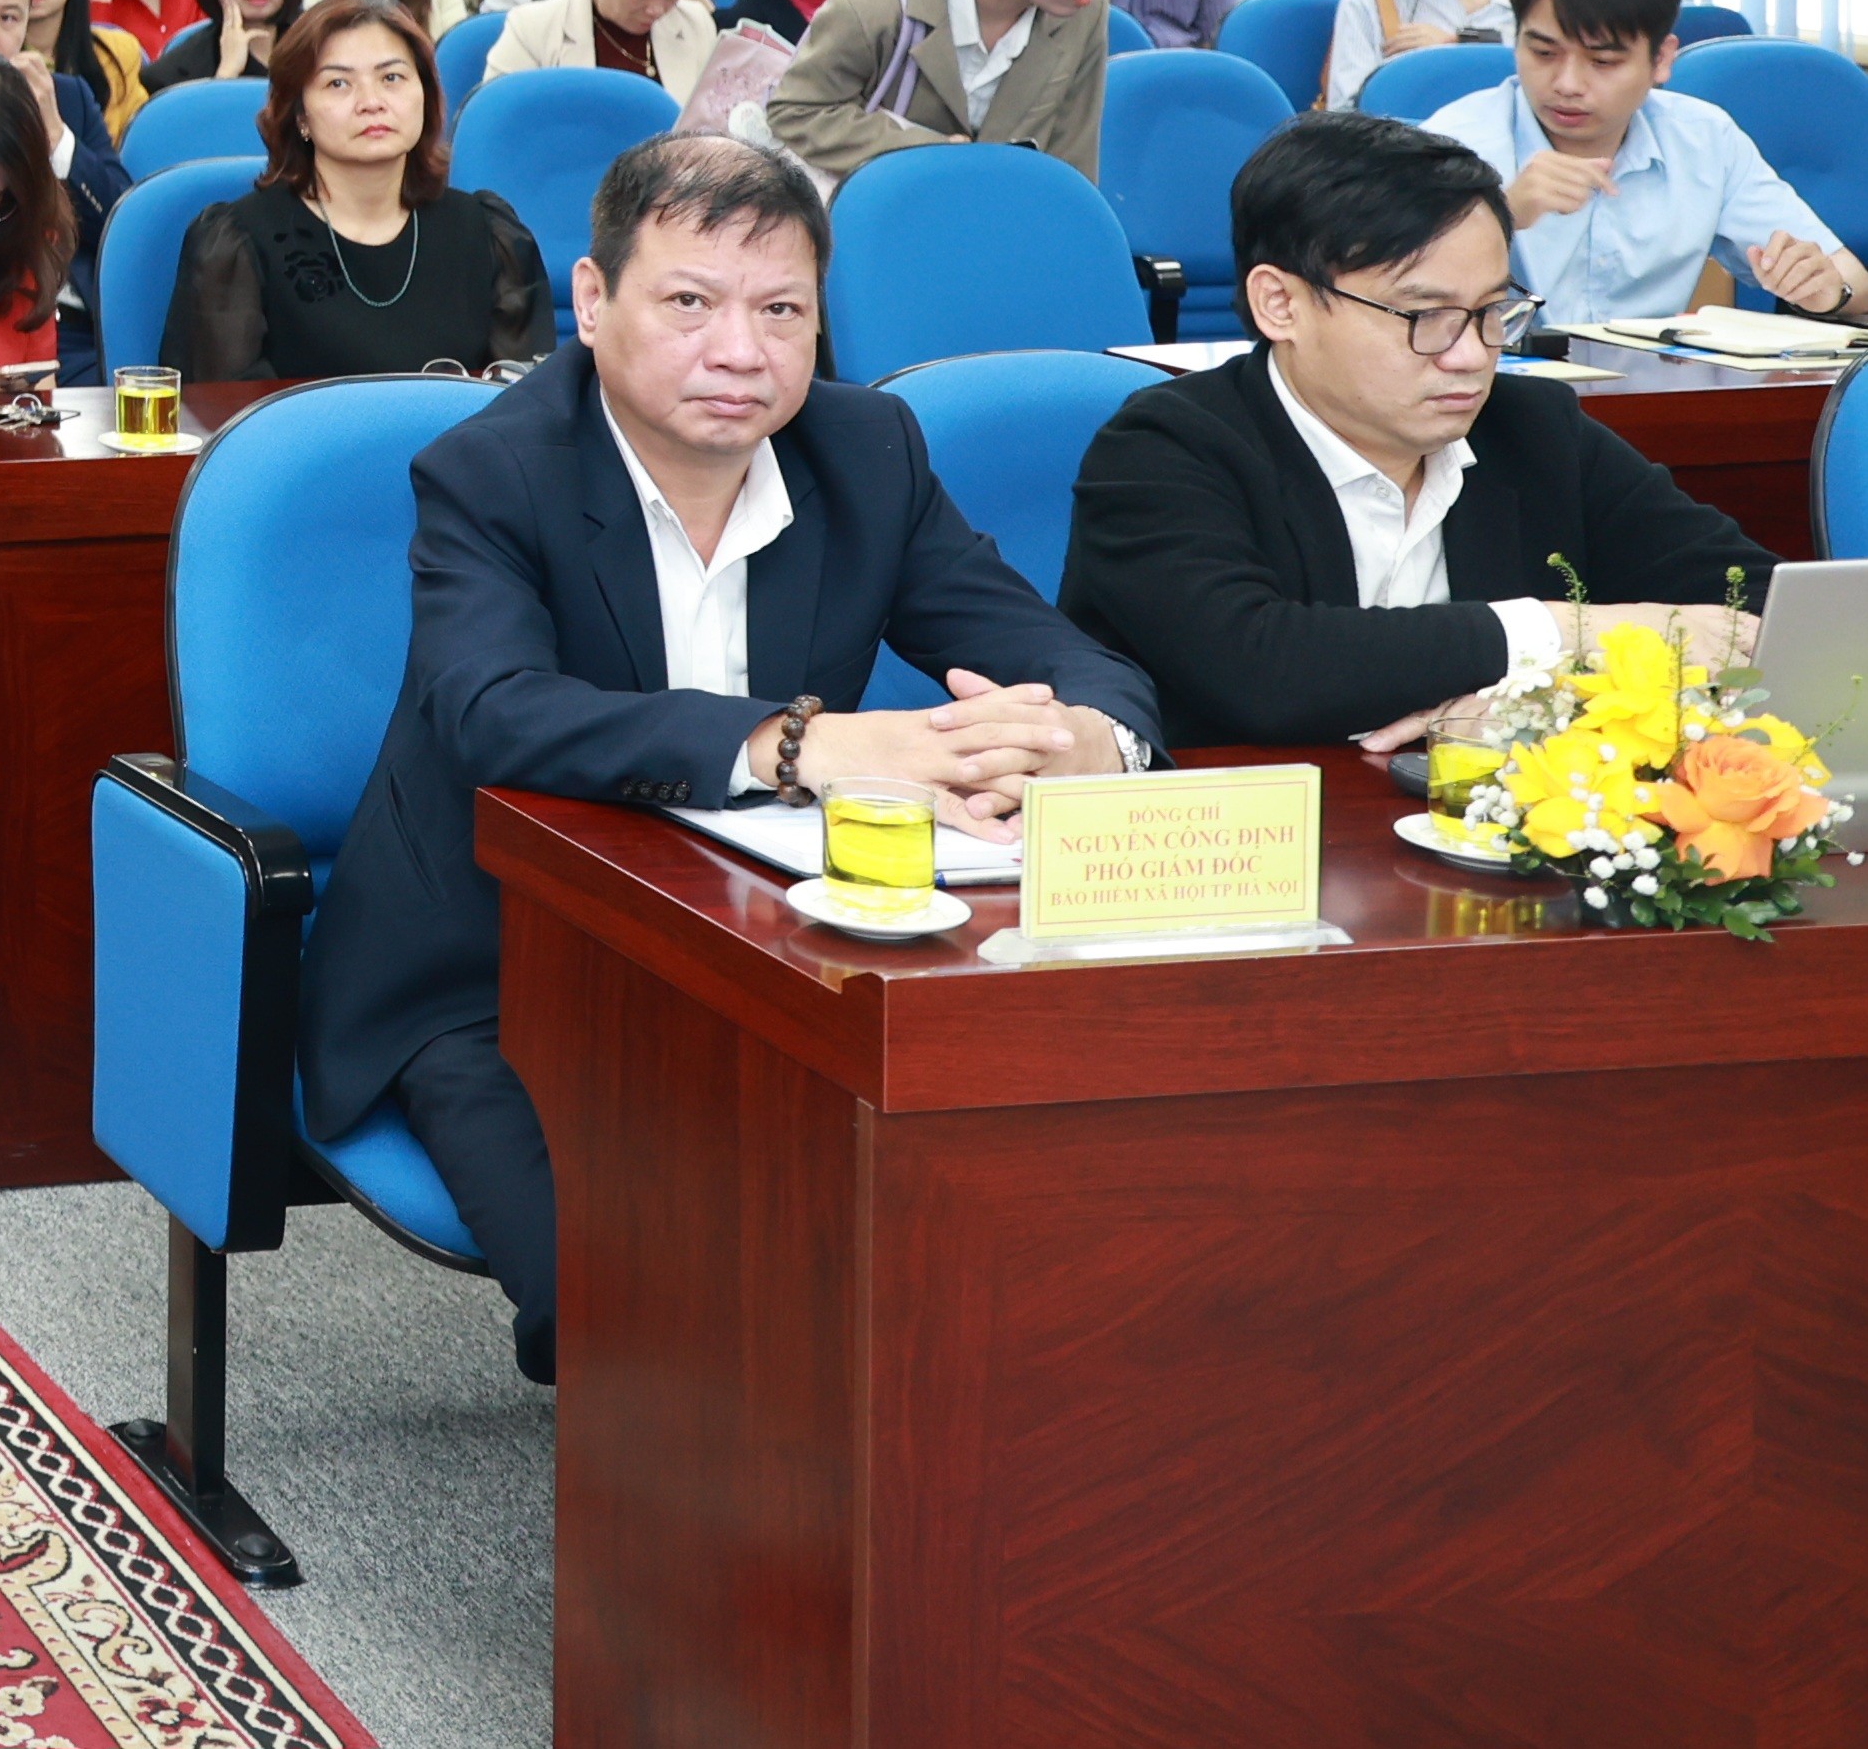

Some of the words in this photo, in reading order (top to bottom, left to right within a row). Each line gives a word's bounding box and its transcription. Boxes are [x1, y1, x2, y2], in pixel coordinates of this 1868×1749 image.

[1186, 801, 1222, 821] CHÍ
[1059, 827, 1158, 855] NGUYỄN
[1164, 824, 1231, 850] CÔNG
[1237, 824, 1295, 850] ĐỊNH
[1083, 856, 1134, 882] PHÓ
[1140, 853, 1205, 879] GIÁM
[1211, 850, 1263, 875] ĐỐC
[1051, 887, 1087, 907] BẢO
[1092, 884, 1140, 905] HIỂM
[1144, 883, 1168, 902] XÃ
[1173, 883, 1207, 903] HỘI
[1211, 883, 1233, 898] TP
[1237, 877, 1262, 896] HÀ
[1267, 879, 1299, 898] NỘI
